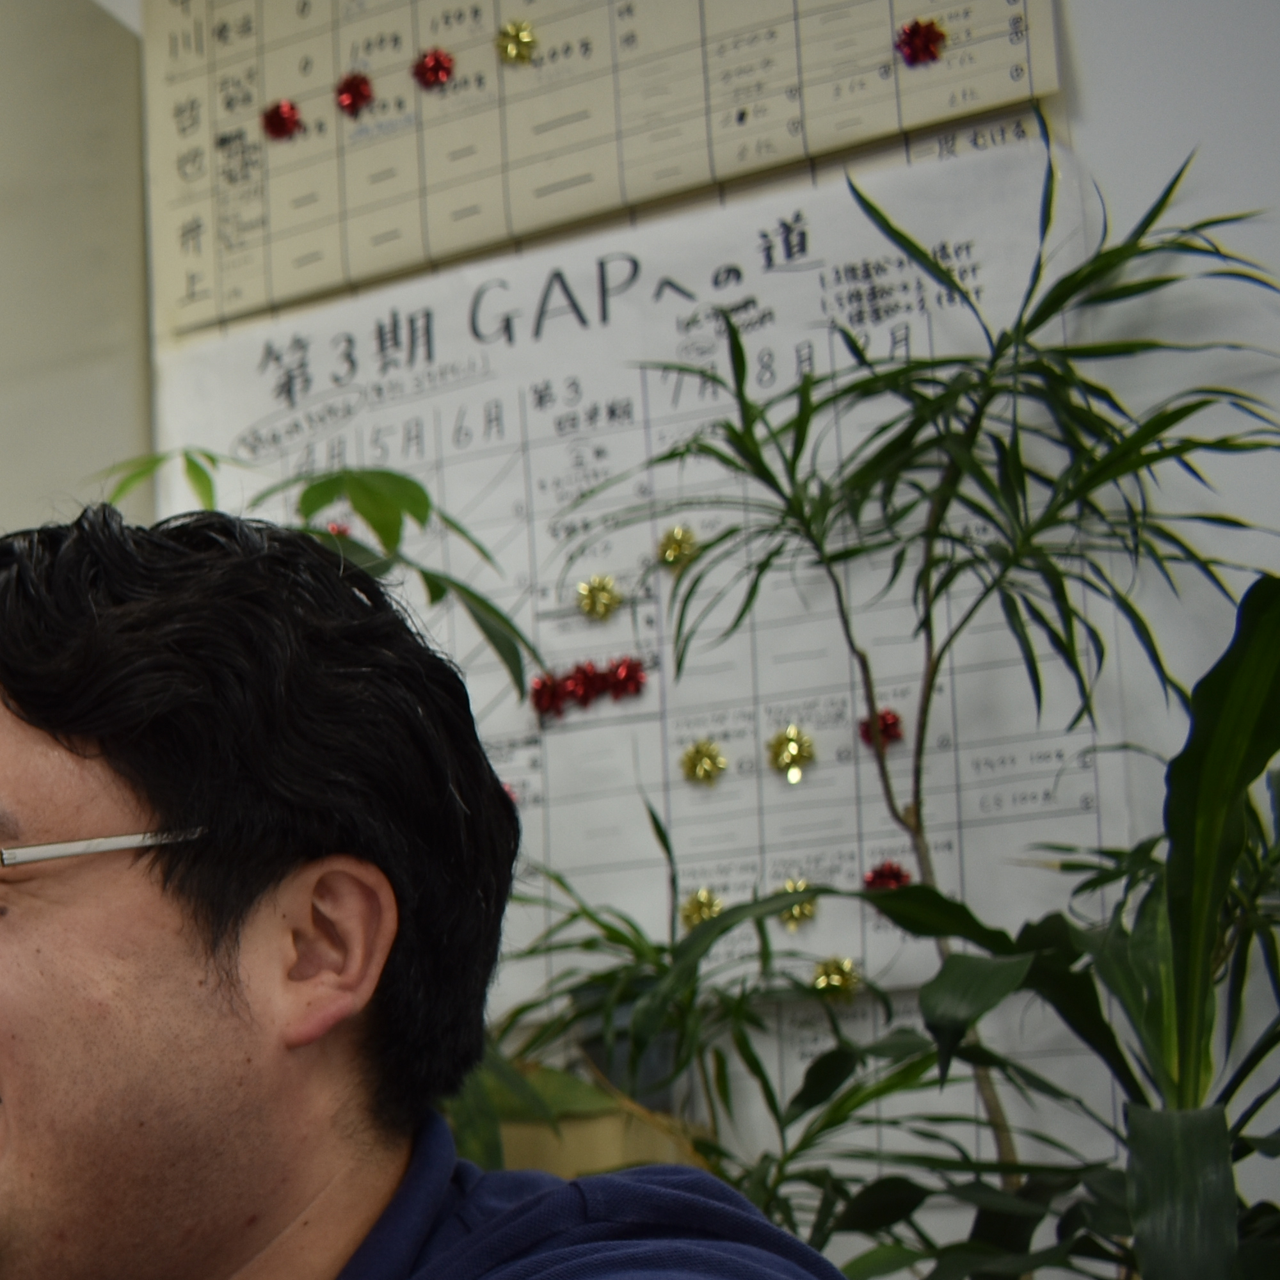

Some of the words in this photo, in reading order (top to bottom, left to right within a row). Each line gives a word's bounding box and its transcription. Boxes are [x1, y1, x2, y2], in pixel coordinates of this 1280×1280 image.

[258, 306, 436, 409] 第3期
[370, 415, 426, 462] 5月
[452, 398, 505, 450] 6月
